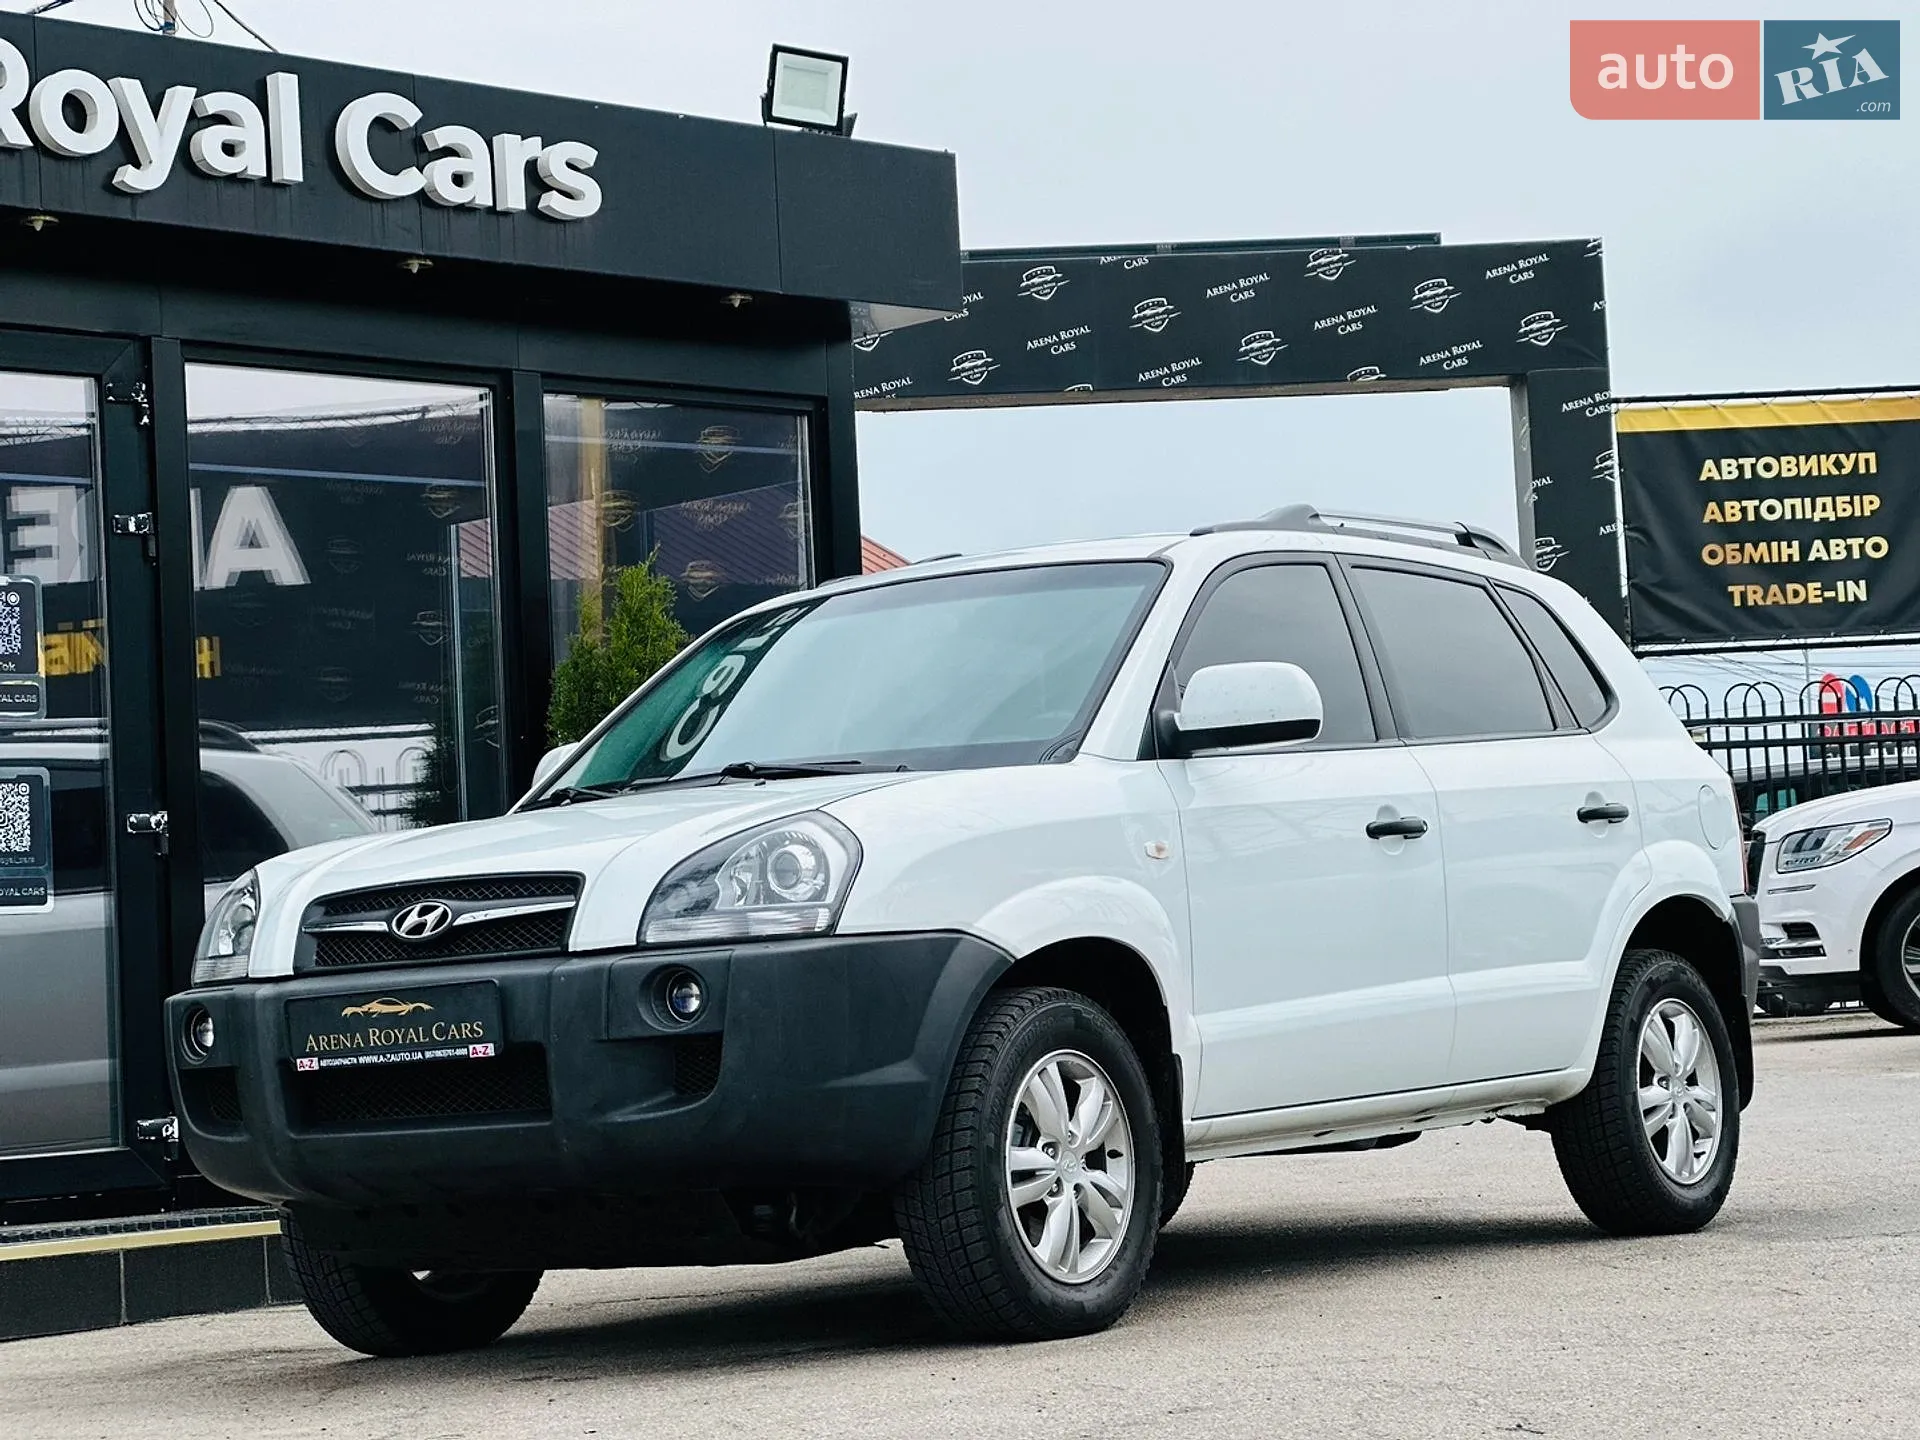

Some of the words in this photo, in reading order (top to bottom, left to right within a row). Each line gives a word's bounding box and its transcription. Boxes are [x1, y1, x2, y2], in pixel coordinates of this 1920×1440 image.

[0, 37, 304, 194] Royal
[335, 91, 603, 220] Cars
[1485, 264, 1517, 280] ARENA
[1518, 253, 1550, 269] ROYAL
[1509, 270, 1535, 284] CARS
[1205, 283, 1238, 299] ARENA
[1238, 272, 1271, 289] ROYAL
[1229, 288, 1256, 303] CARS
[1313, 315, 1346, 331] ARENA
[1346, 304, 1379, 321] ROYAL
[1337, 321, 1364, 335] CARS
[1026, 334, 1059, 351] ARENA
[1059, 324, 1092, 341] ROYAL
[1050, 340, 1077, 355] CARS
[1419, 350, 1450, 366] ARENA
[1451, 340, 1484, 357] ROYAL
[1442, 356, 1469, 371] CARS
[1138, 367, 1170, 383] ARENA
[1170, 356, 1203, 373] ROYAL
[1161, 372, 1188, 387] CARS
[880, 376, 913, 393] ROYAL
[1699, 451, 1878, 481] АВТОВИКУП
[1702, 494, 1882, 523] АВТОПІДБІР
[1701, 539, 1800, 566] ОБМІН
[1807, 535, 1889, 562] АВТО
[1727, 579, 1868, 607] TRADE-IN
[14, 694, 38, 703] CARS
[305, 1033, 364, 1053] ARENA
[368, 1026, 430, 1047] ROYAL
[432, 1021, 484, 1041] CARS
